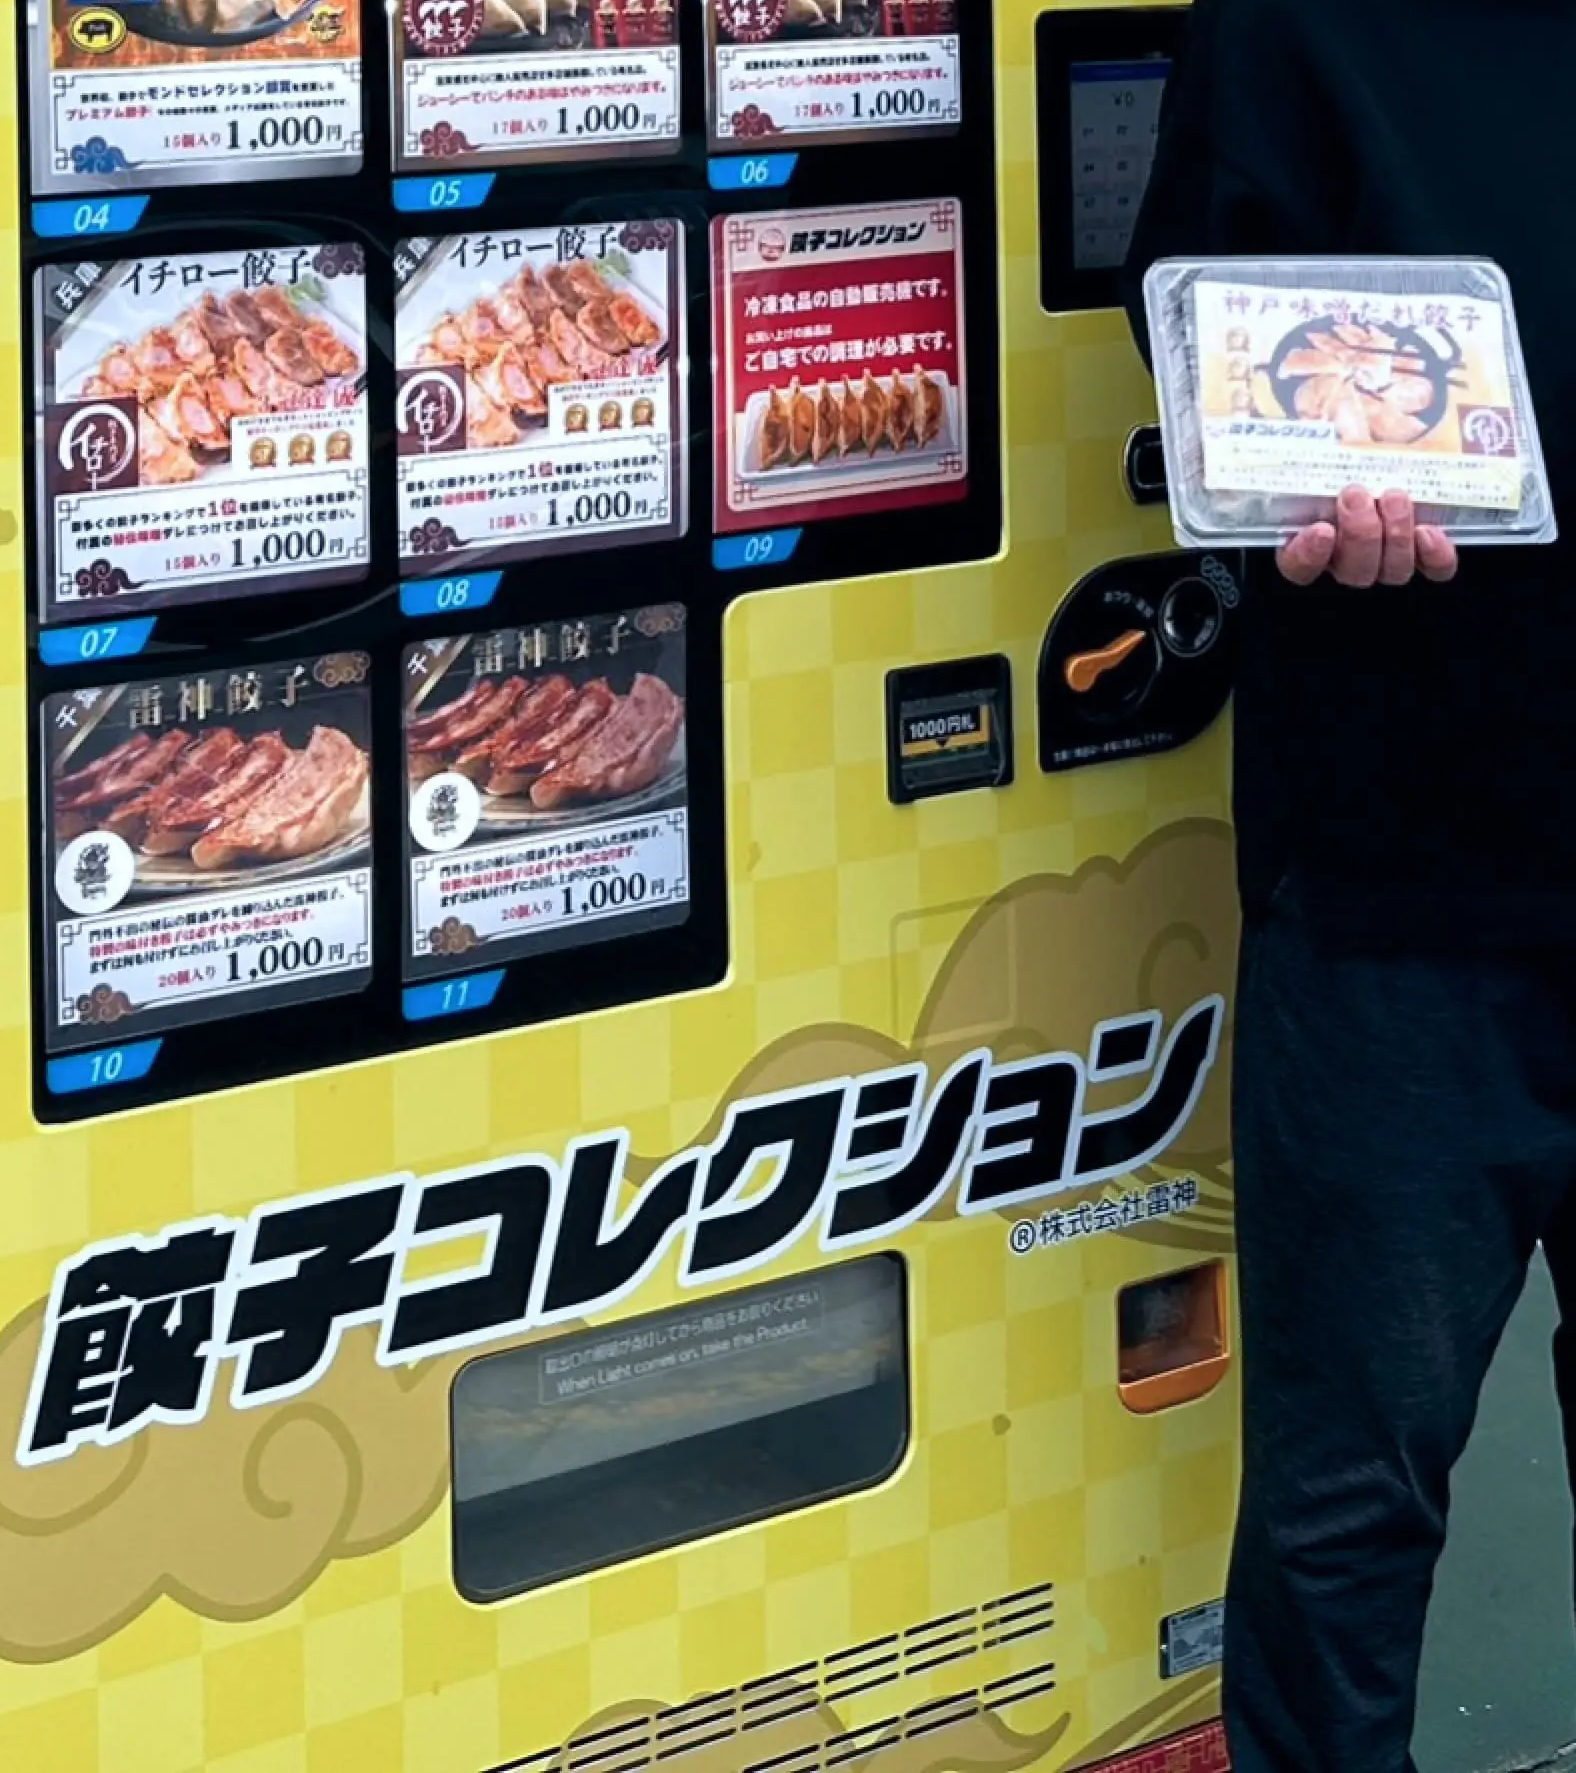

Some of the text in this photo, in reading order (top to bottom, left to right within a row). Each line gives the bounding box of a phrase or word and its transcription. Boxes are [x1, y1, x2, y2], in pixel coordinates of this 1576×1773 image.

[558, 103, 656, 135] 1,000円
[852, 88, 941, 118] 1,000円
[226, 115, 342, 150] 1,000円
[741, 159, 769, 185] 06
[429, 181, 461, 205] 05
[73, 205, 110, 230] 04
[450, 225, 616, 267] イチロー餃子
[790, 222, 925, 254] 餃子コレクション
[121, 248, 311, 295] イチロー餃子
[744, 278, 948, 317] 冷凍食品の自動販売機です。
[1224, 290, 1481, 330] 神戸味噌だれ餃子
[745, 330, 952, 371] ご自宅での調理が必要です。
[548, 491, 646, 526] 1,000円
[232, 528, 344, 568] 1,000円
[745, 537, 773, 562] 09
[437, 581, 468, 606] 08
[80, 628, 117, 656] 07
[475, 616, 630, 675] 雷神餃子
[130, 664, 310, 728] 雷神餃子
[561, 872, 665, 916] 1,000円
[227, 937, 344, 982] 1,000円
[442, 980, 469, 1010] 11
[90, 1053, 124, 1082] 10
[24, 1007, 1220, 1457] 餃子コレクション
[703, 1339, 730, 1355] take
[734, 1331, 754, 1348] the
